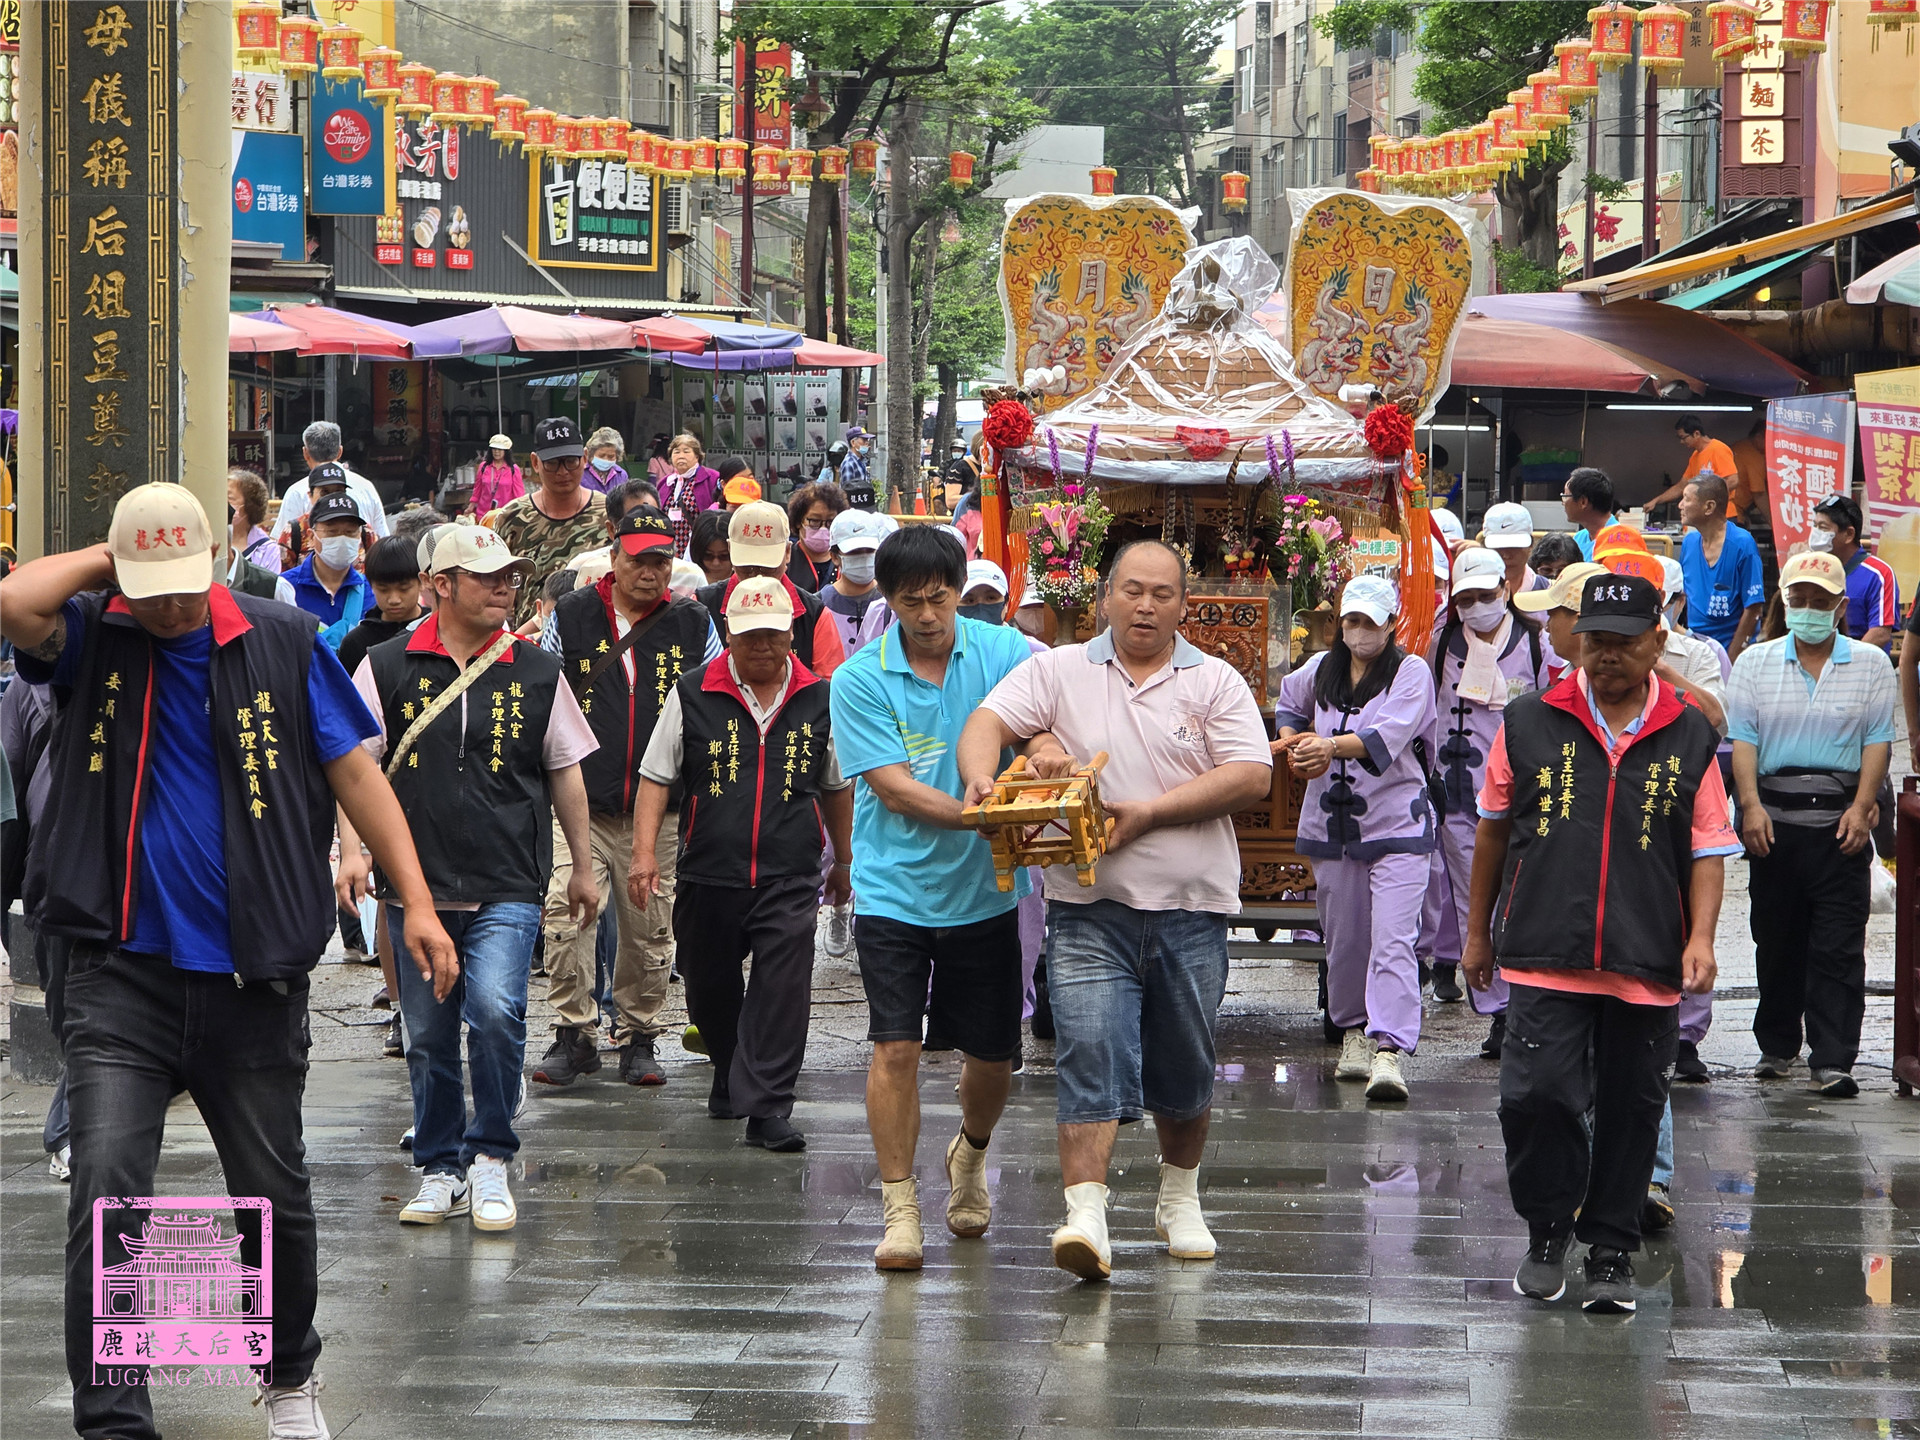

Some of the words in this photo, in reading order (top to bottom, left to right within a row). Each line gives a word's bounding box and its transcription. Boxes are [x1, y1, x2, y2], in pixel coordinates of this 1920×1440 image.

[323, 131, 371, 152] Family
[331, 114, 355, 128] We
[344, 126, 360, 134] are
[257, 193, 298, 212] 台灣彩券
[322, 174, 373, 189] 台灣彩券
[577, 159, 650, 211] 便便屋
[79, 5, 134, 545] 母儀稱后俎豆奠邦
[1076, 259, 1107, 313] 月
[1363, 263, 1396, 315] 日
[546, 427, 570, 440] 龍天宮
[134, 526, 187, 551] 龍天宮
[474, 533, 507, 550] 龍天
[742, 523, 774, 539] 龍天宮
[1355, 540, 1401, 556] 地標美
[1798, 558, 1832, 574] 龍天宮
[740, 592, 774, 608] 龍天宮
[1593, 584, 1633, 602] 龍天宮
[669, 644, 685, 686] 龍天
[254, 690, 280, 770] 龍天宮
[488, 691, 506, 773] 管理委員會
[508, 681, 525, 739] 龍天宮
[236, 707, 268, 820] 管理委員會
[726, 718, 741, 783] 副主任委員
[780, 730, 798, 802] 管理委員會
[800, 722, 813, 774] 龍天宮
[1536, 766, 1554, 837] 蕭世昌
[1558, 741, 1576, 820] 副主任委員
[1662, 755, 1683, 816] 龍天宮
[1637, 763, 1662, 851] 管理委員會
